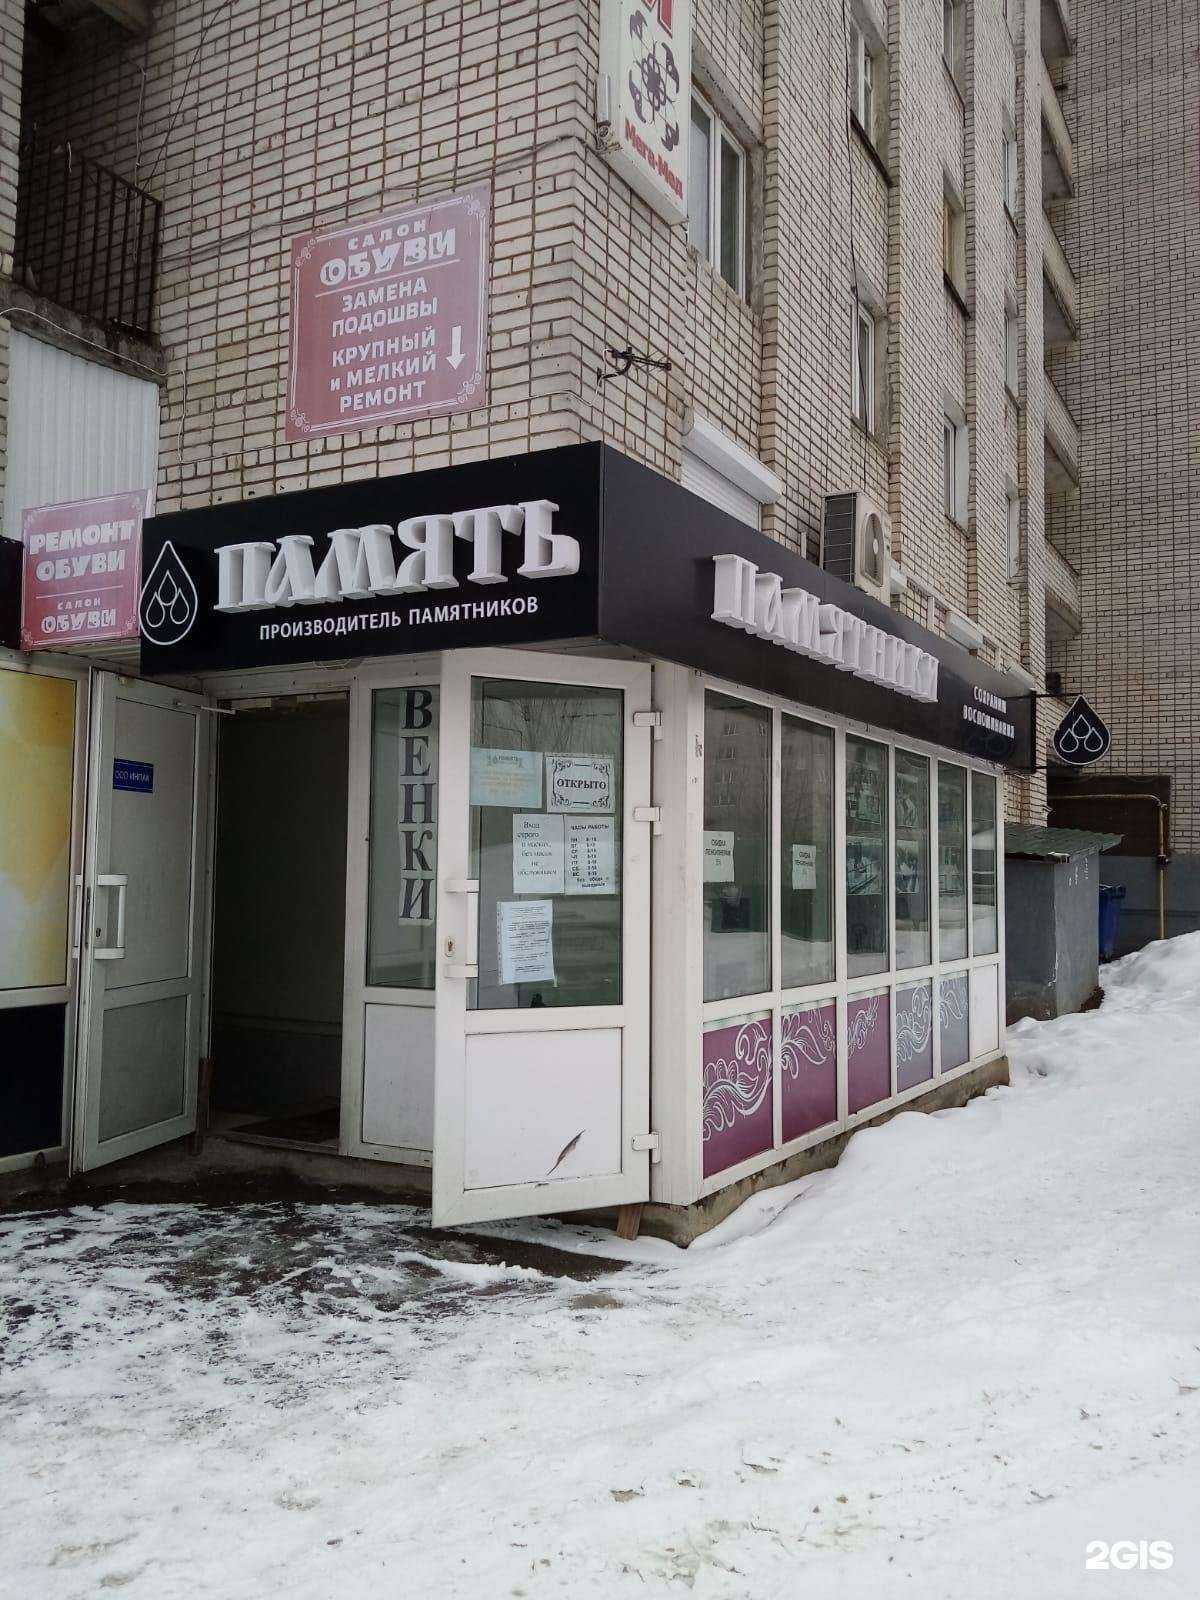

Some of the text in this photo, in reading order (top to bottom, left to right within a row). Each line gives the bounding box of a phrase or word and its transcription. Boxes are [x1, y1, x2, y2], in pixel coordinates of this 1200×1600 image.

[347, 219, 427, 250] САЛОН
[319, 228, 457, 286] ОБУВИ
[341, 276, 428, 313] ЗАМЕНА
[331, 296, 438, 338] ПОДОШВЫ
[332, 325, 436, 368] КРУПНЫЙ
[346, 352, 438, 389] МЕЛКИЙ
[339, 380, 427, 413] РЕМОНТ
[29, 519, 135, 556] РЕМОНТ
[213, 498, 581, 614] ПАМЯТЬ
[35, 549, 126, 582] ОБУВИ
[41, 608, 117, 635] ОБУВИ
[57, 597, 101, 611] САЛОН
[259, 596, 539, 641] ПРОИЗВОДИТЕЛЬ ПАМЯТНИКОВ
[556, 779, 607, 790] ОТКРЫТО
[399, 689, 437, 920] ВЕНКИ
